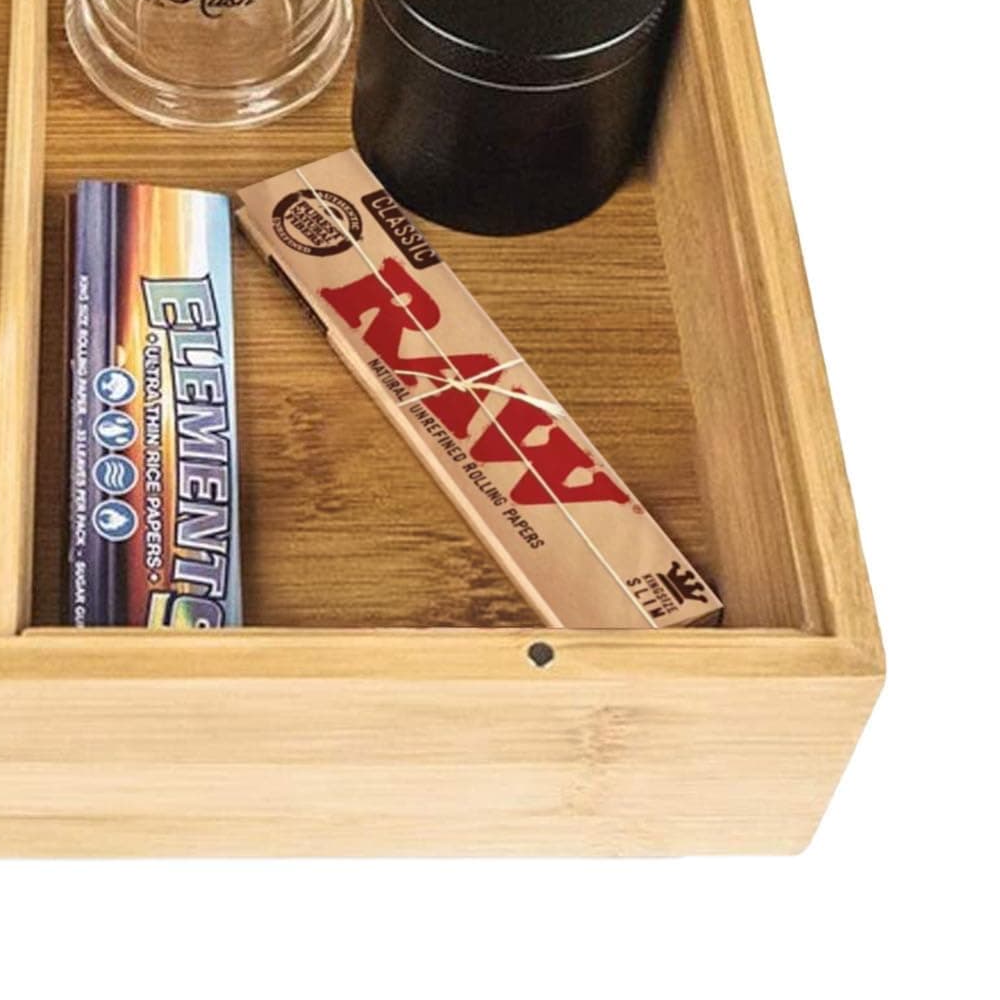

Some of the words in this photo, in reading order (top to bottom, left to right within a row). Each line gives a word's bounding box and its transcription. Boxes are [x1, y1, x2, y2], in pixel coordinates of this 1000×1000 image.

[371, 196, 437, 262] CLASSIC
[145, 346, 162, 401] ULTRA
[316, 256, 631, 506] RAW
[145, 403, 163, 445] THIN
[145, 452, 162, 494] RICE
[368, 358, 411, 401] NATURAL
[409, 403, 466, 463] UNREFINED
[462, 461, 508, 507] ROLLING
[502, 508, 545, 549] PAPERS
[75, 514, 86, 546] PACK
[145, 497, 163, 569] PAPERS
[75, 561, 86, 603] SUGAR
[626, 577, 666, 618] SLIM
